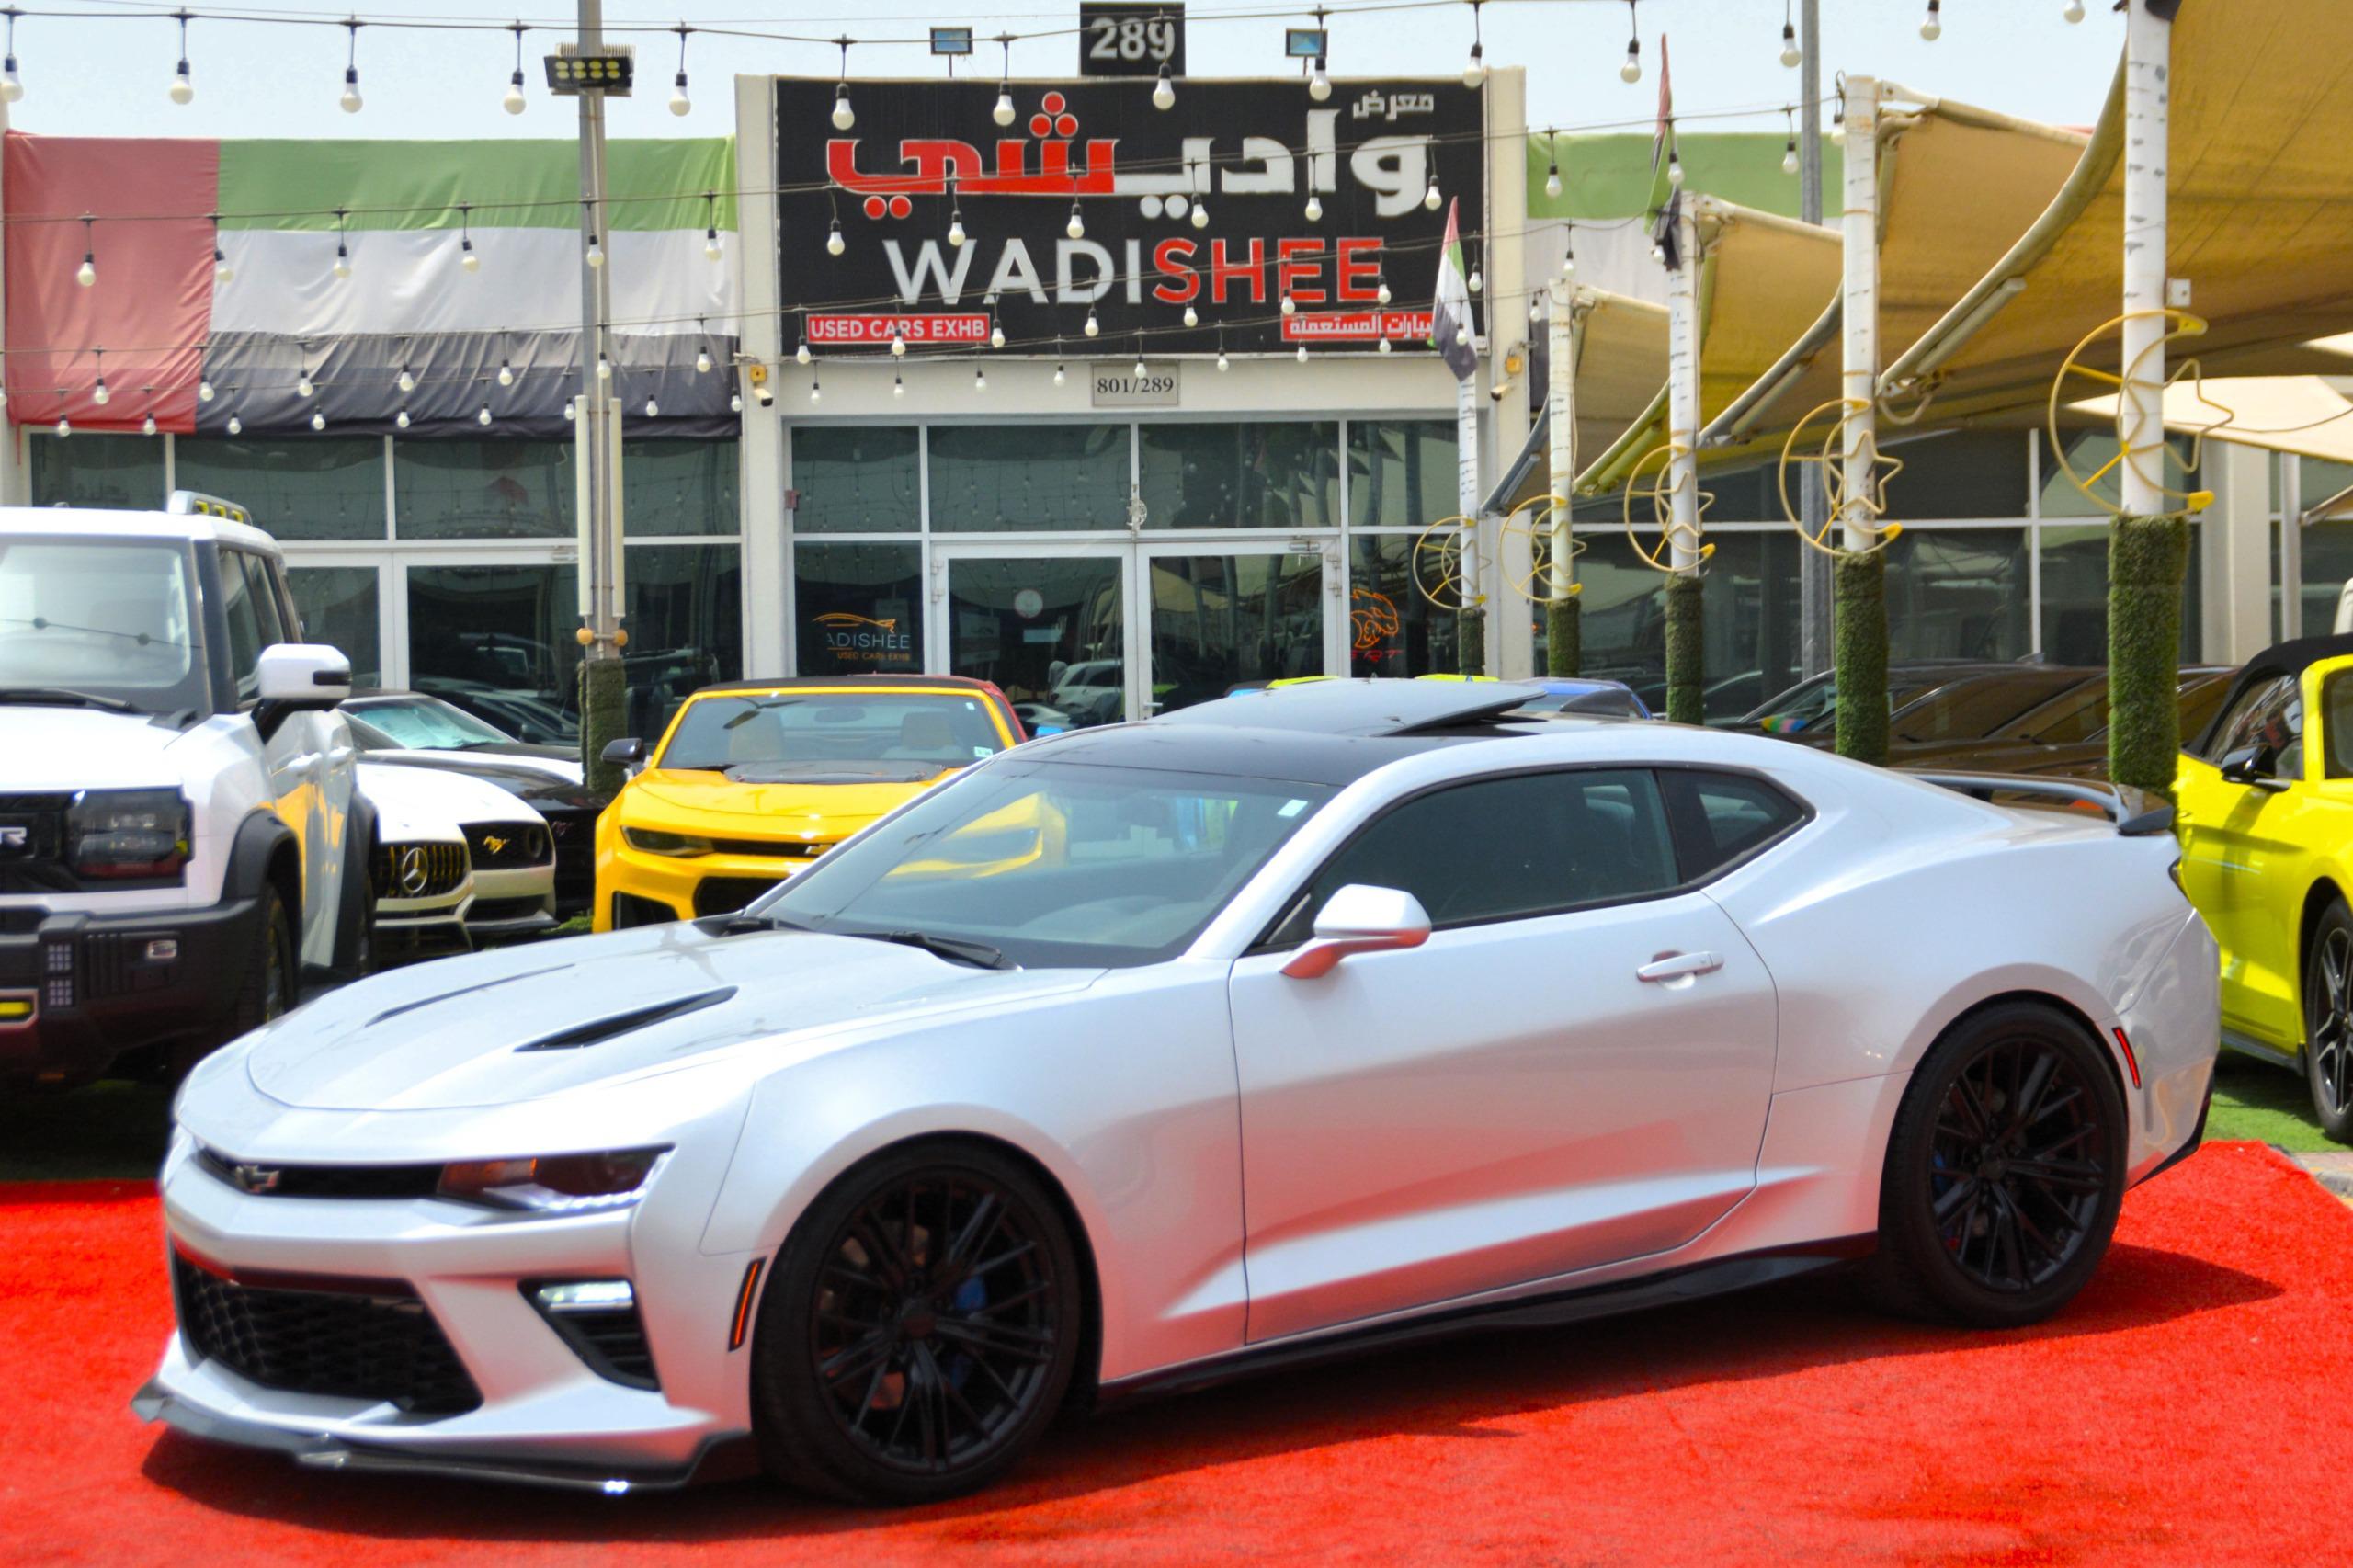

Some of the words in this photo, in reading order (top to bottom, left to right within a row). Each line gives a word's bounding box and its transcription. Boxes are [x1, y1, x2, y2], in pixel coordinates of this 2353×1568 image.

[1088, 16, 1175, 60] 289
[1352, 89, 1434, 121] معرض
[882, 237, 1384, 305] WADISHEE
[810, 319, 864, 338] USED
[870, 319, 925, 338] CARS
[931, 319, 986, 338] EXHB
[1097, 377, 1174, 394] 801/289
